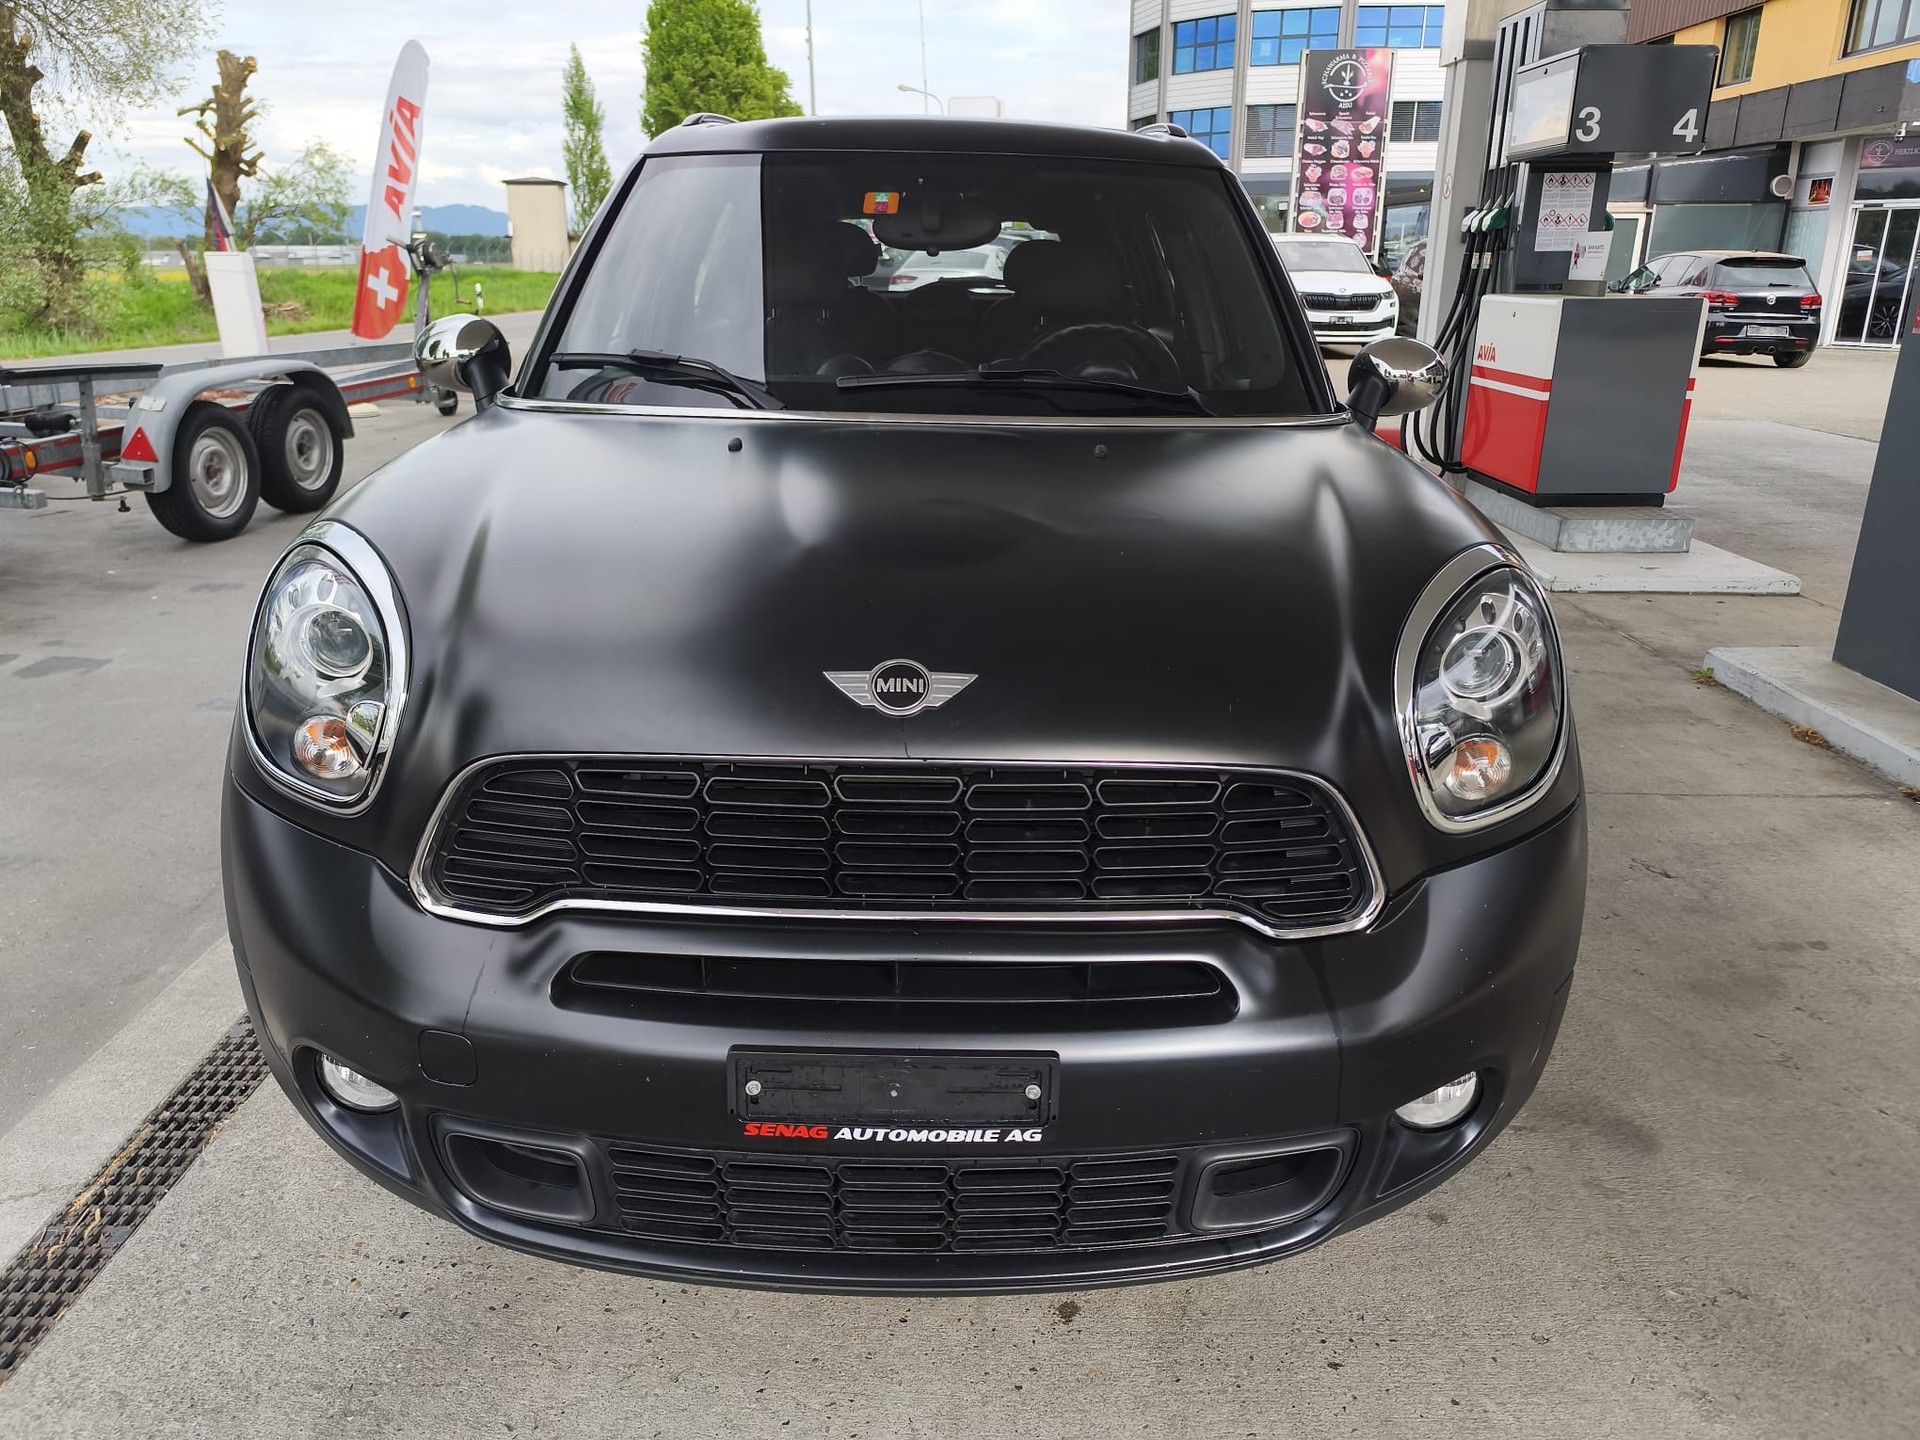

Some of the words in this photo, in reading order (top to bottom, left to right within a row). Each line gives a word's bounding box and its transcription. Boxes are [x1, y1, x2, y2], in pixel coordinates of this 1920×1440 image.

[1575, 106, 1602, 143] 3
[1672, 108, 1699, 143] 4
[384, 96, 421, 223] AVIA
[1477, 342, 1496, 362] AVIA
[876, 678, 924, 693] MINI
[743, 1123, 829, 1139] SENAG
[833, 1126, 1001, 1143] AUTOMOBILE
[1004, 1128, 1043, 1143] AG
